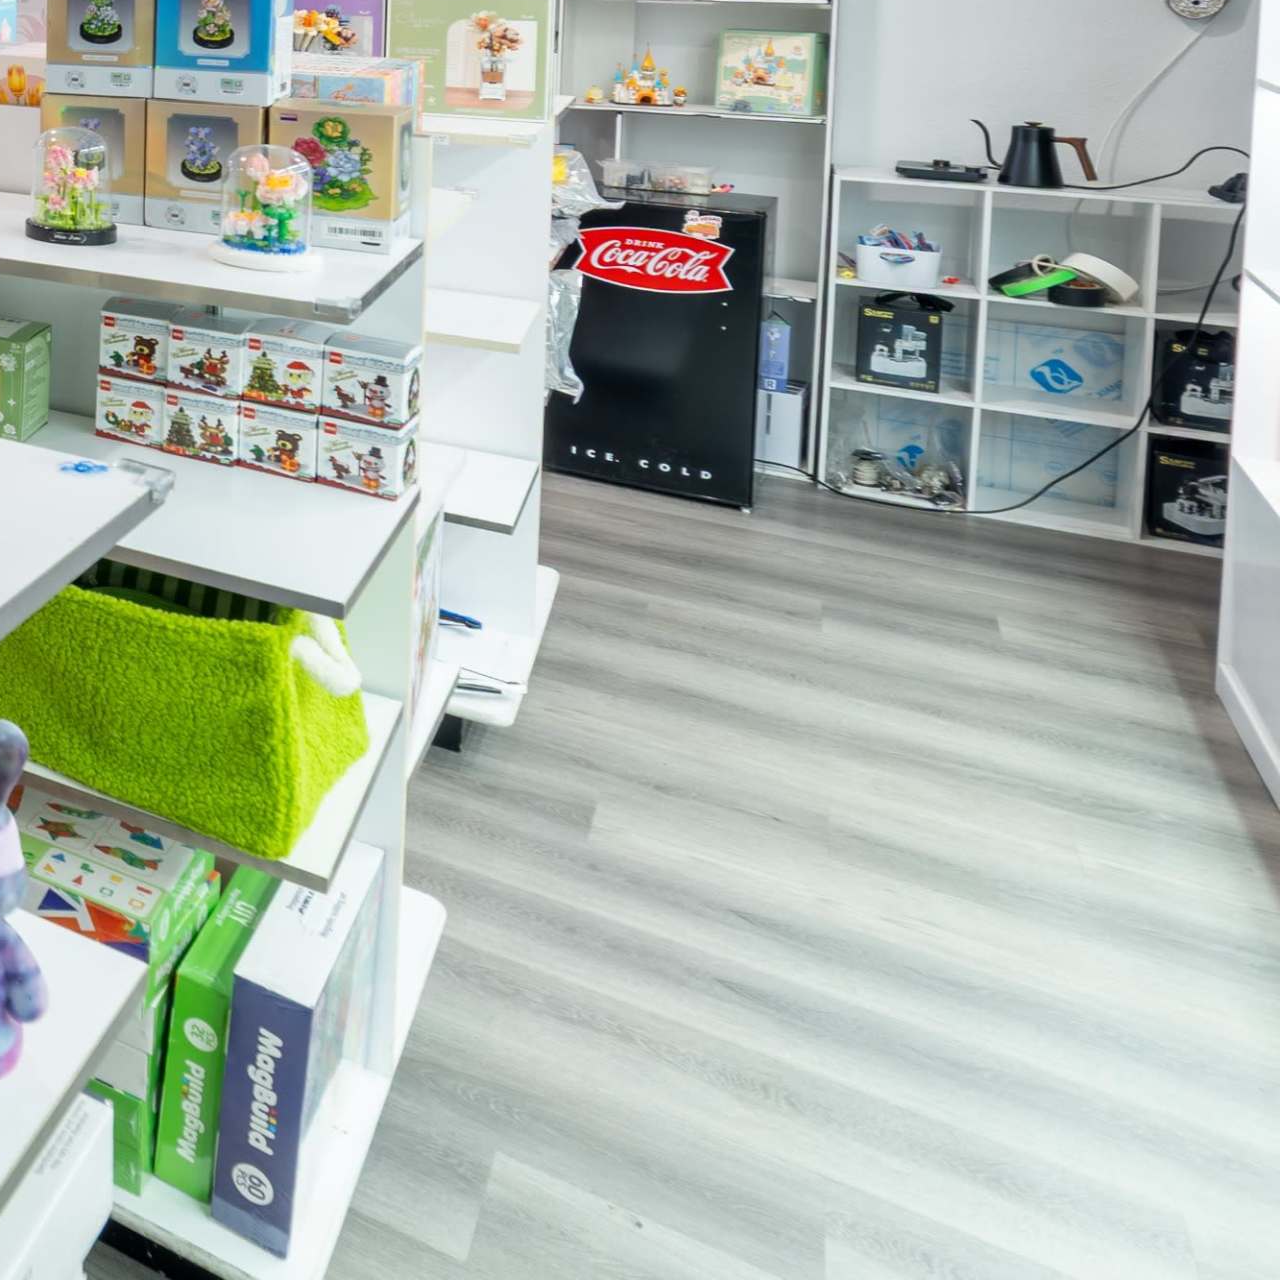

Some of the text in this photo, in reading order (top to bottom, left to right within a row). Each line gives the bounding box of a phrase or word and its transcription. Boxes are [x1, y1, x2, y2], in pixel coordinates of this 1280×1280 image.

[624, 238, 665, 249] DRINK
[638, 458, 713, 480] COLD
[246, 1026, 284, 1156] MagBuild
[175, 1059, 206, 1164] MagBuild
[247, 1174, 268, 1201] 60
